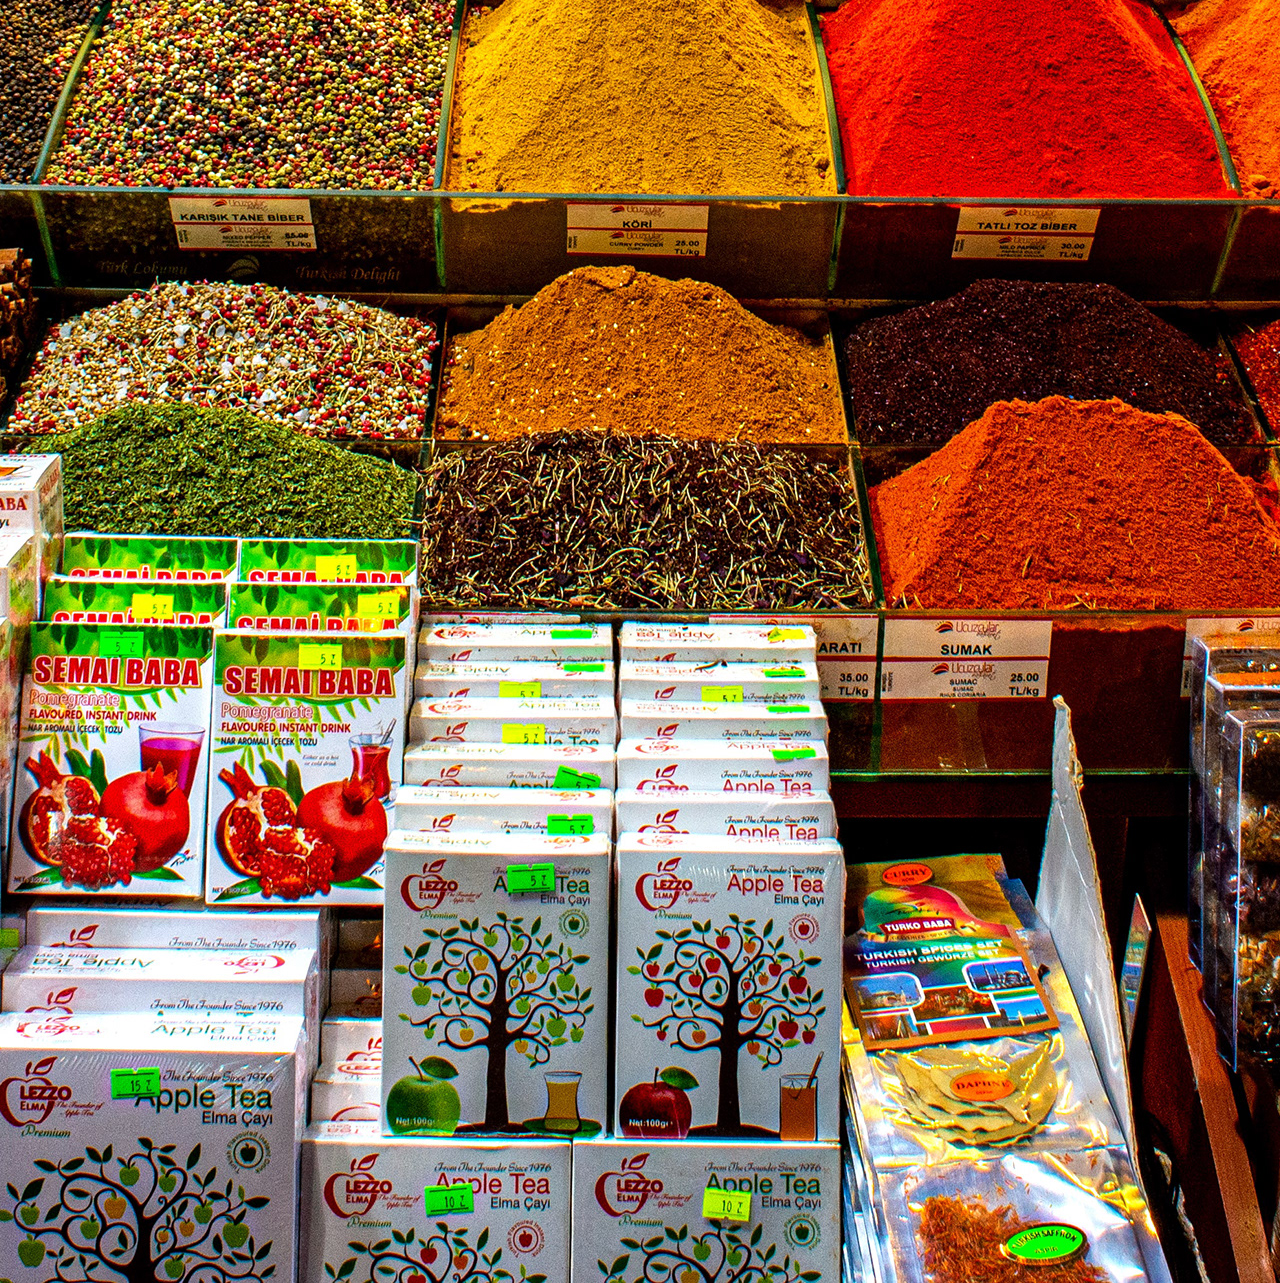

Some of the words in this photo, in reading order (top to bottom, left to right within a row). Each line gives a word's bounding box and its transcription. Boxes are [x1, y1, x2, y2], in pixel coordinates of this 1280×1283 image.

[180, 213, 228, 223] KARIŞIK
[231, 213, 264, 222] TANE
[267, 212, 305, 222] BİBER
[623, 219, 652, 228] KÖRİ
[976, 221, 1013, 231] TATLI
[1013, 221, 1041, 231] TOZ
[1042, 221, 1078, 231] BİBER
[674, 240, 700, 248] 25.00
[1060, 242, 1085, 250] 30.00
[674, 247, 700, 257] TL/kg
[941, 644, 991, 655] SUMAK
[839, 673, 869, 683] 35.00
[1010, 673, 1040, 683] 25.00
[1010, 686, 1039, 697] TL/kg
[29, 724, 41, 733] NAR
[45, 724, 73, 733] AROMALI
[105, 725, 123, 734] TOZU
[222, 723, 275, 733] FLAVOURED
[279, 723, 318, 733] INSTANT
[321, 723, 351, 733] DRINK
[884, 868, 928, 880] CURRY
[727, 875, 783, 897] Apple
[791, 875, 823, 893] Tea
[418, 892, 439, 900] ELMA
[540, 895, 564, 904] Elma
[568, 895, 590, 906] Çayı
[885, 922, 920, 931] TURKO
[923, 919, 951, 929] BABA
[855, 948, 917, 961] TURKISH
[977, 940, 1003, 949] SET
[864, 958, 914, 968] TURKISH
[978, 948, 1000, 957] SET
[20, 1087, 71, 1100] LEZZO
[202, 1112, 237, 1125] Elma
[242, 1112, 272, 1127] Çayı
[21, 1126, 70, 1139] Premium
[346, 1180, 392, 1193] LEZZO
[346, 1194, 369, 1203] ELMA
[617, 1194, 640, 1203] ELMA
